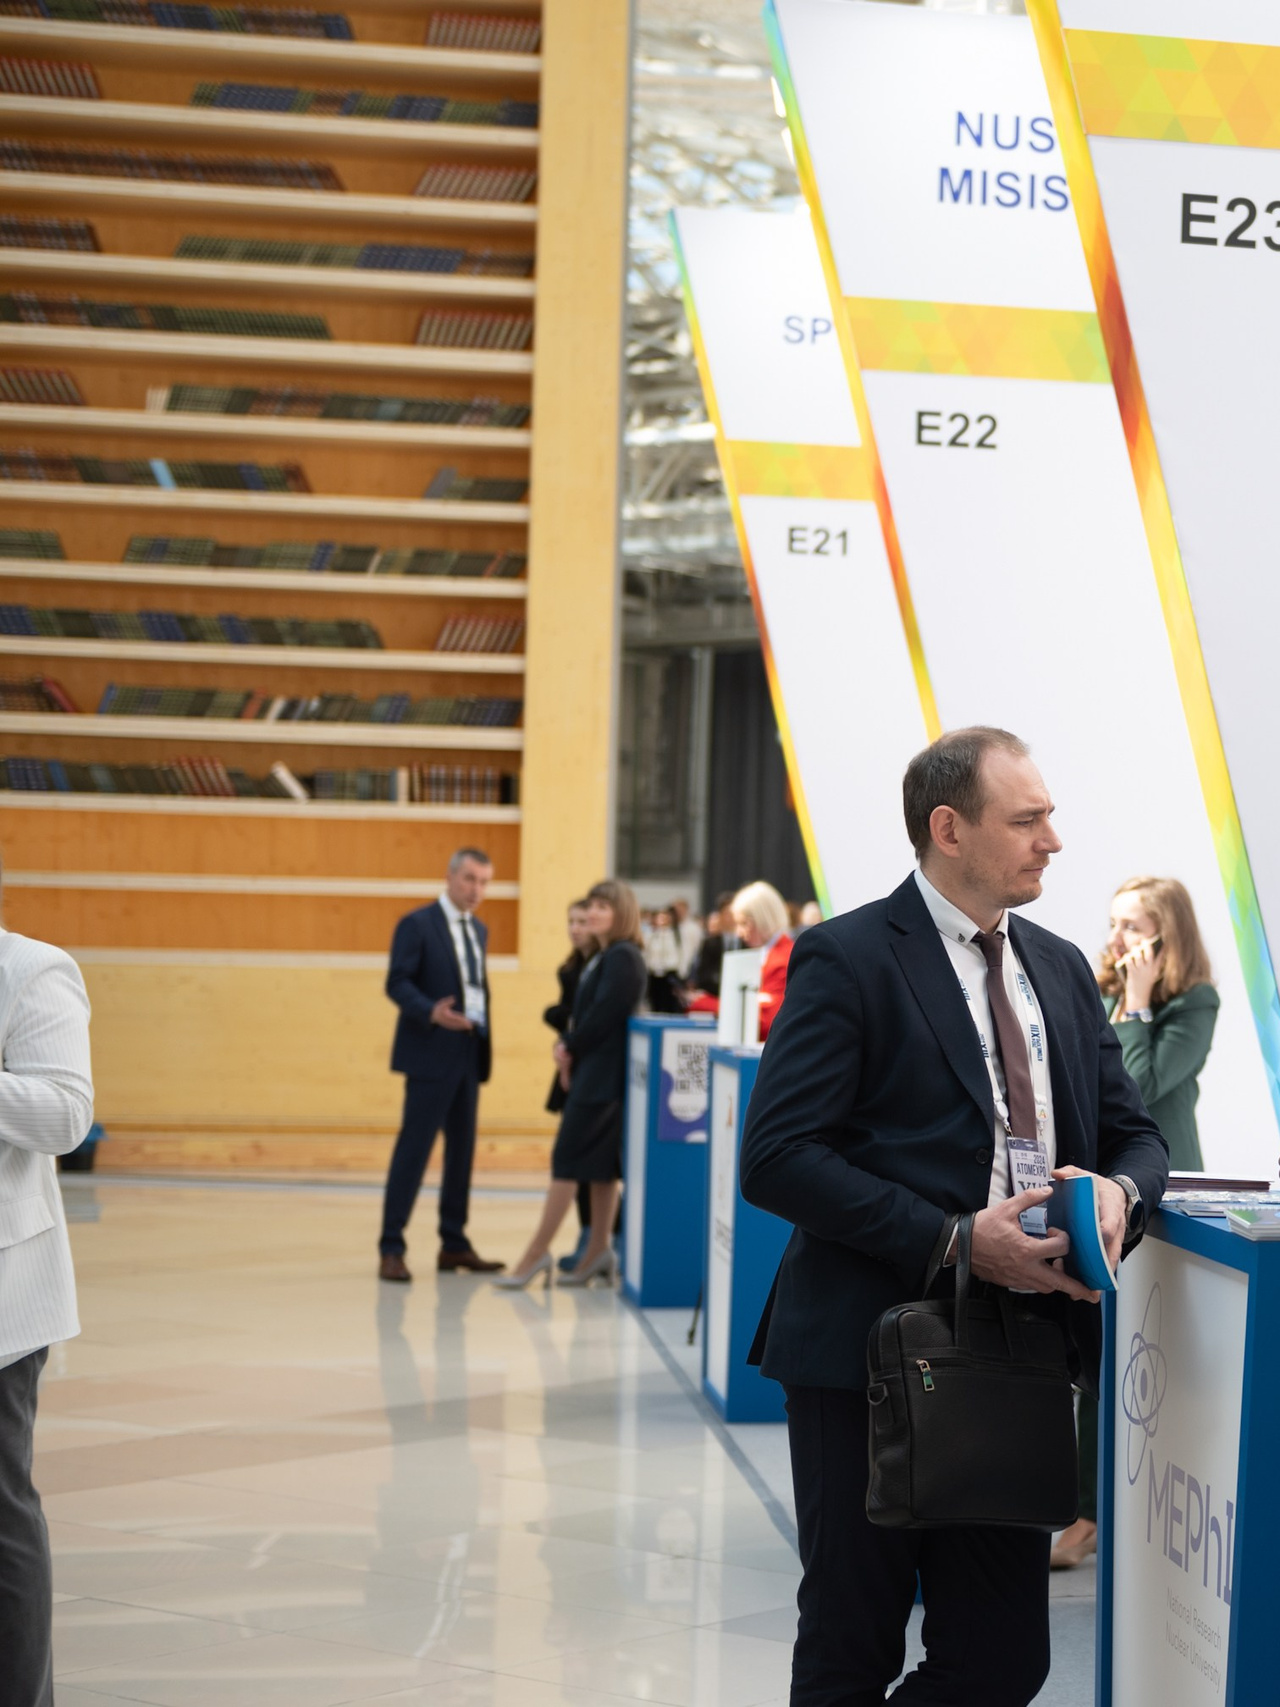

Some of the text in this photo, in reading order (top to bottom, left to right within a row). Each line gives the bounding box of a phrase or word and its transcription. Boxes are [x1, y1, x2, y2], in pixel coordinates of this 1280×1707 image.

[937, 165, 1070, 212] MISIS
[915, 409, 998, 450] E22
[787, 525, 850, 557] E21
[1016, 1162, 1047, 1178] ATOMEXPO
[1033, 1154, 1046, 1165] 2024
[1146, 1448, 1234, 1607] MEPhI
[1166, 1586, 1222, 1652] National Research
[1165, 1621, 1222, 1694] Nuclear University
